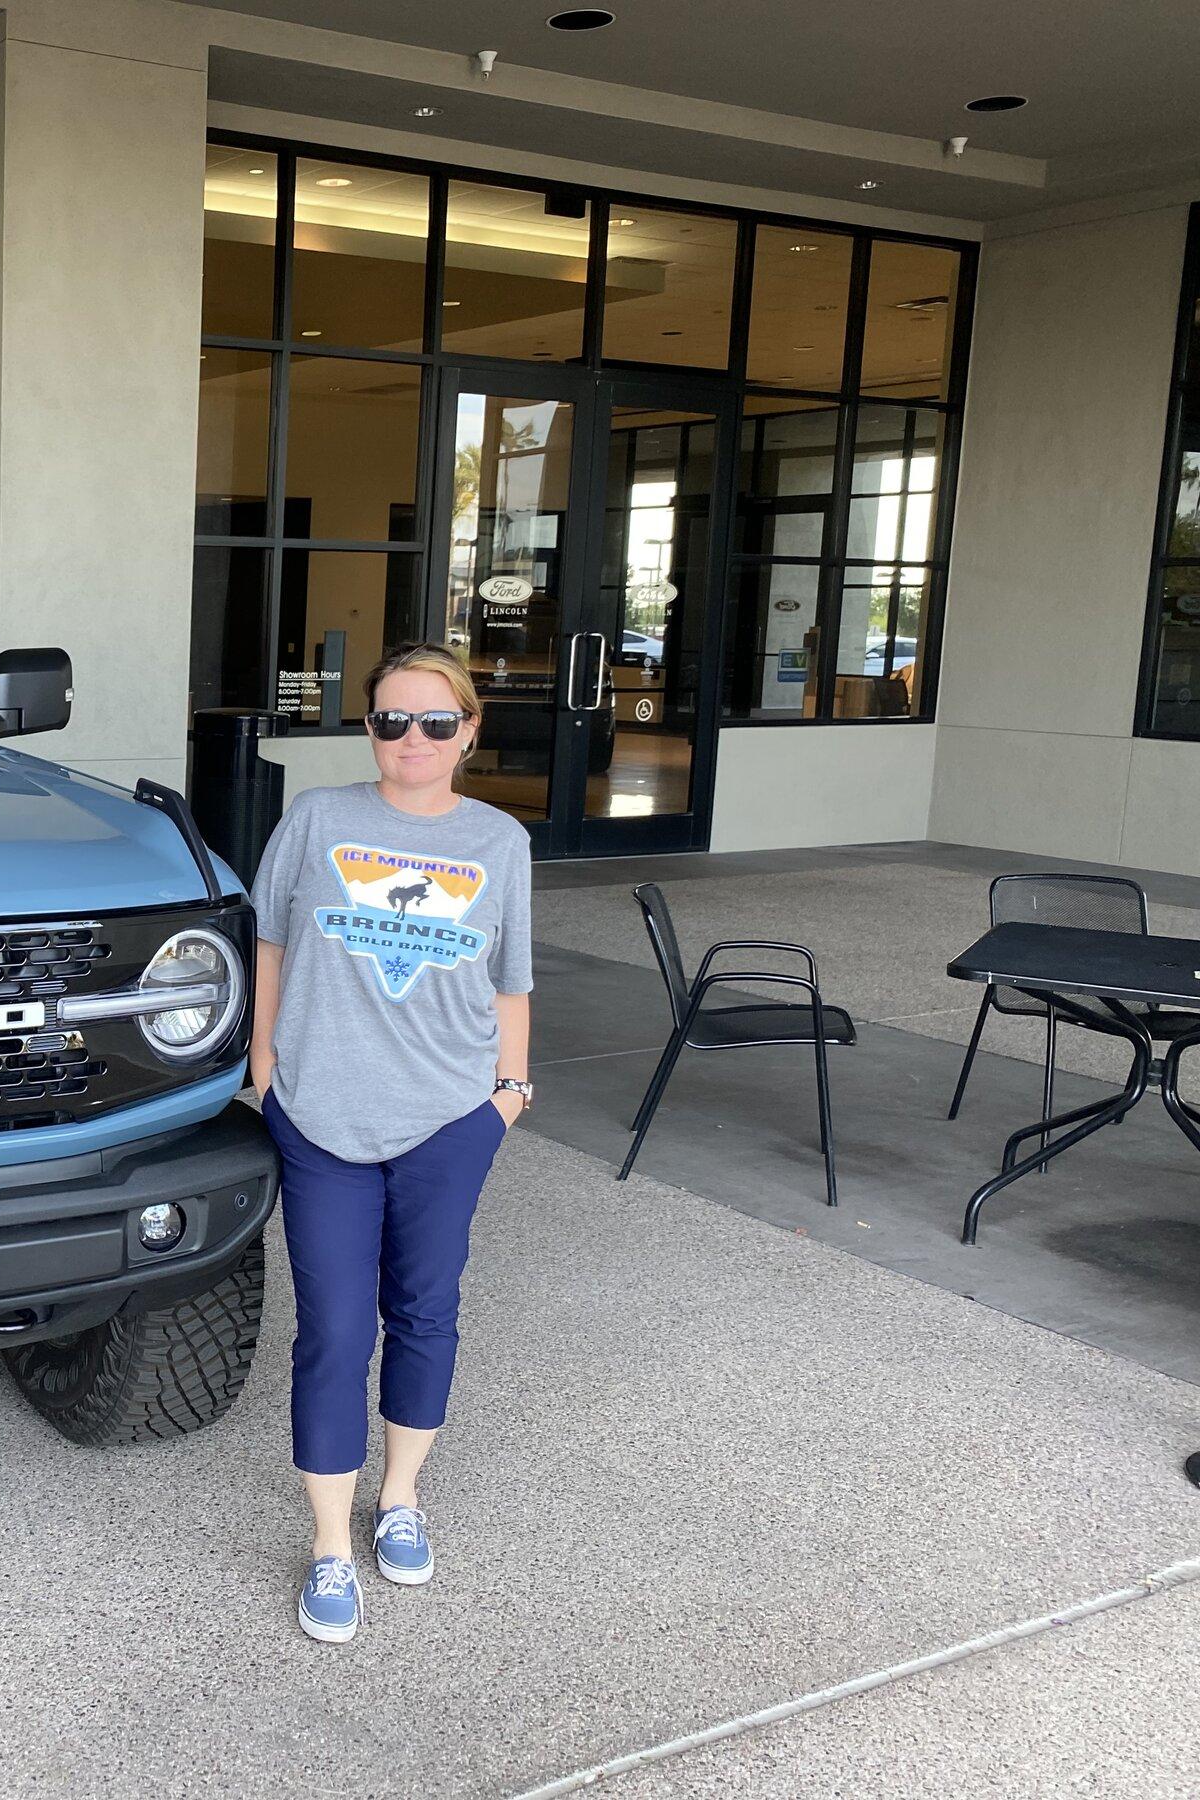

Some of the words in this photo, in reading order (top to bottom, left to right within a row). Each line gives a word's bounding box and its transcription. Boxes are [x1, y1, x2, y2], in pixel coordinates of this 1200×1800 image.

[490, 580, 521, 597] Ford
[490, 607, 528, 615] LINCOLN
[279, 671, 318, 679] Showroom
[321, 671, 341, 679] Hours
[343, 850, 373, 863] ICE
[377, 854, 477, 883] MOUNTAIN
[326, 914, 478, 949] BRONCO
[346, 935, 393, 947] COLD
[398, 942, 457, 958] BATCH
